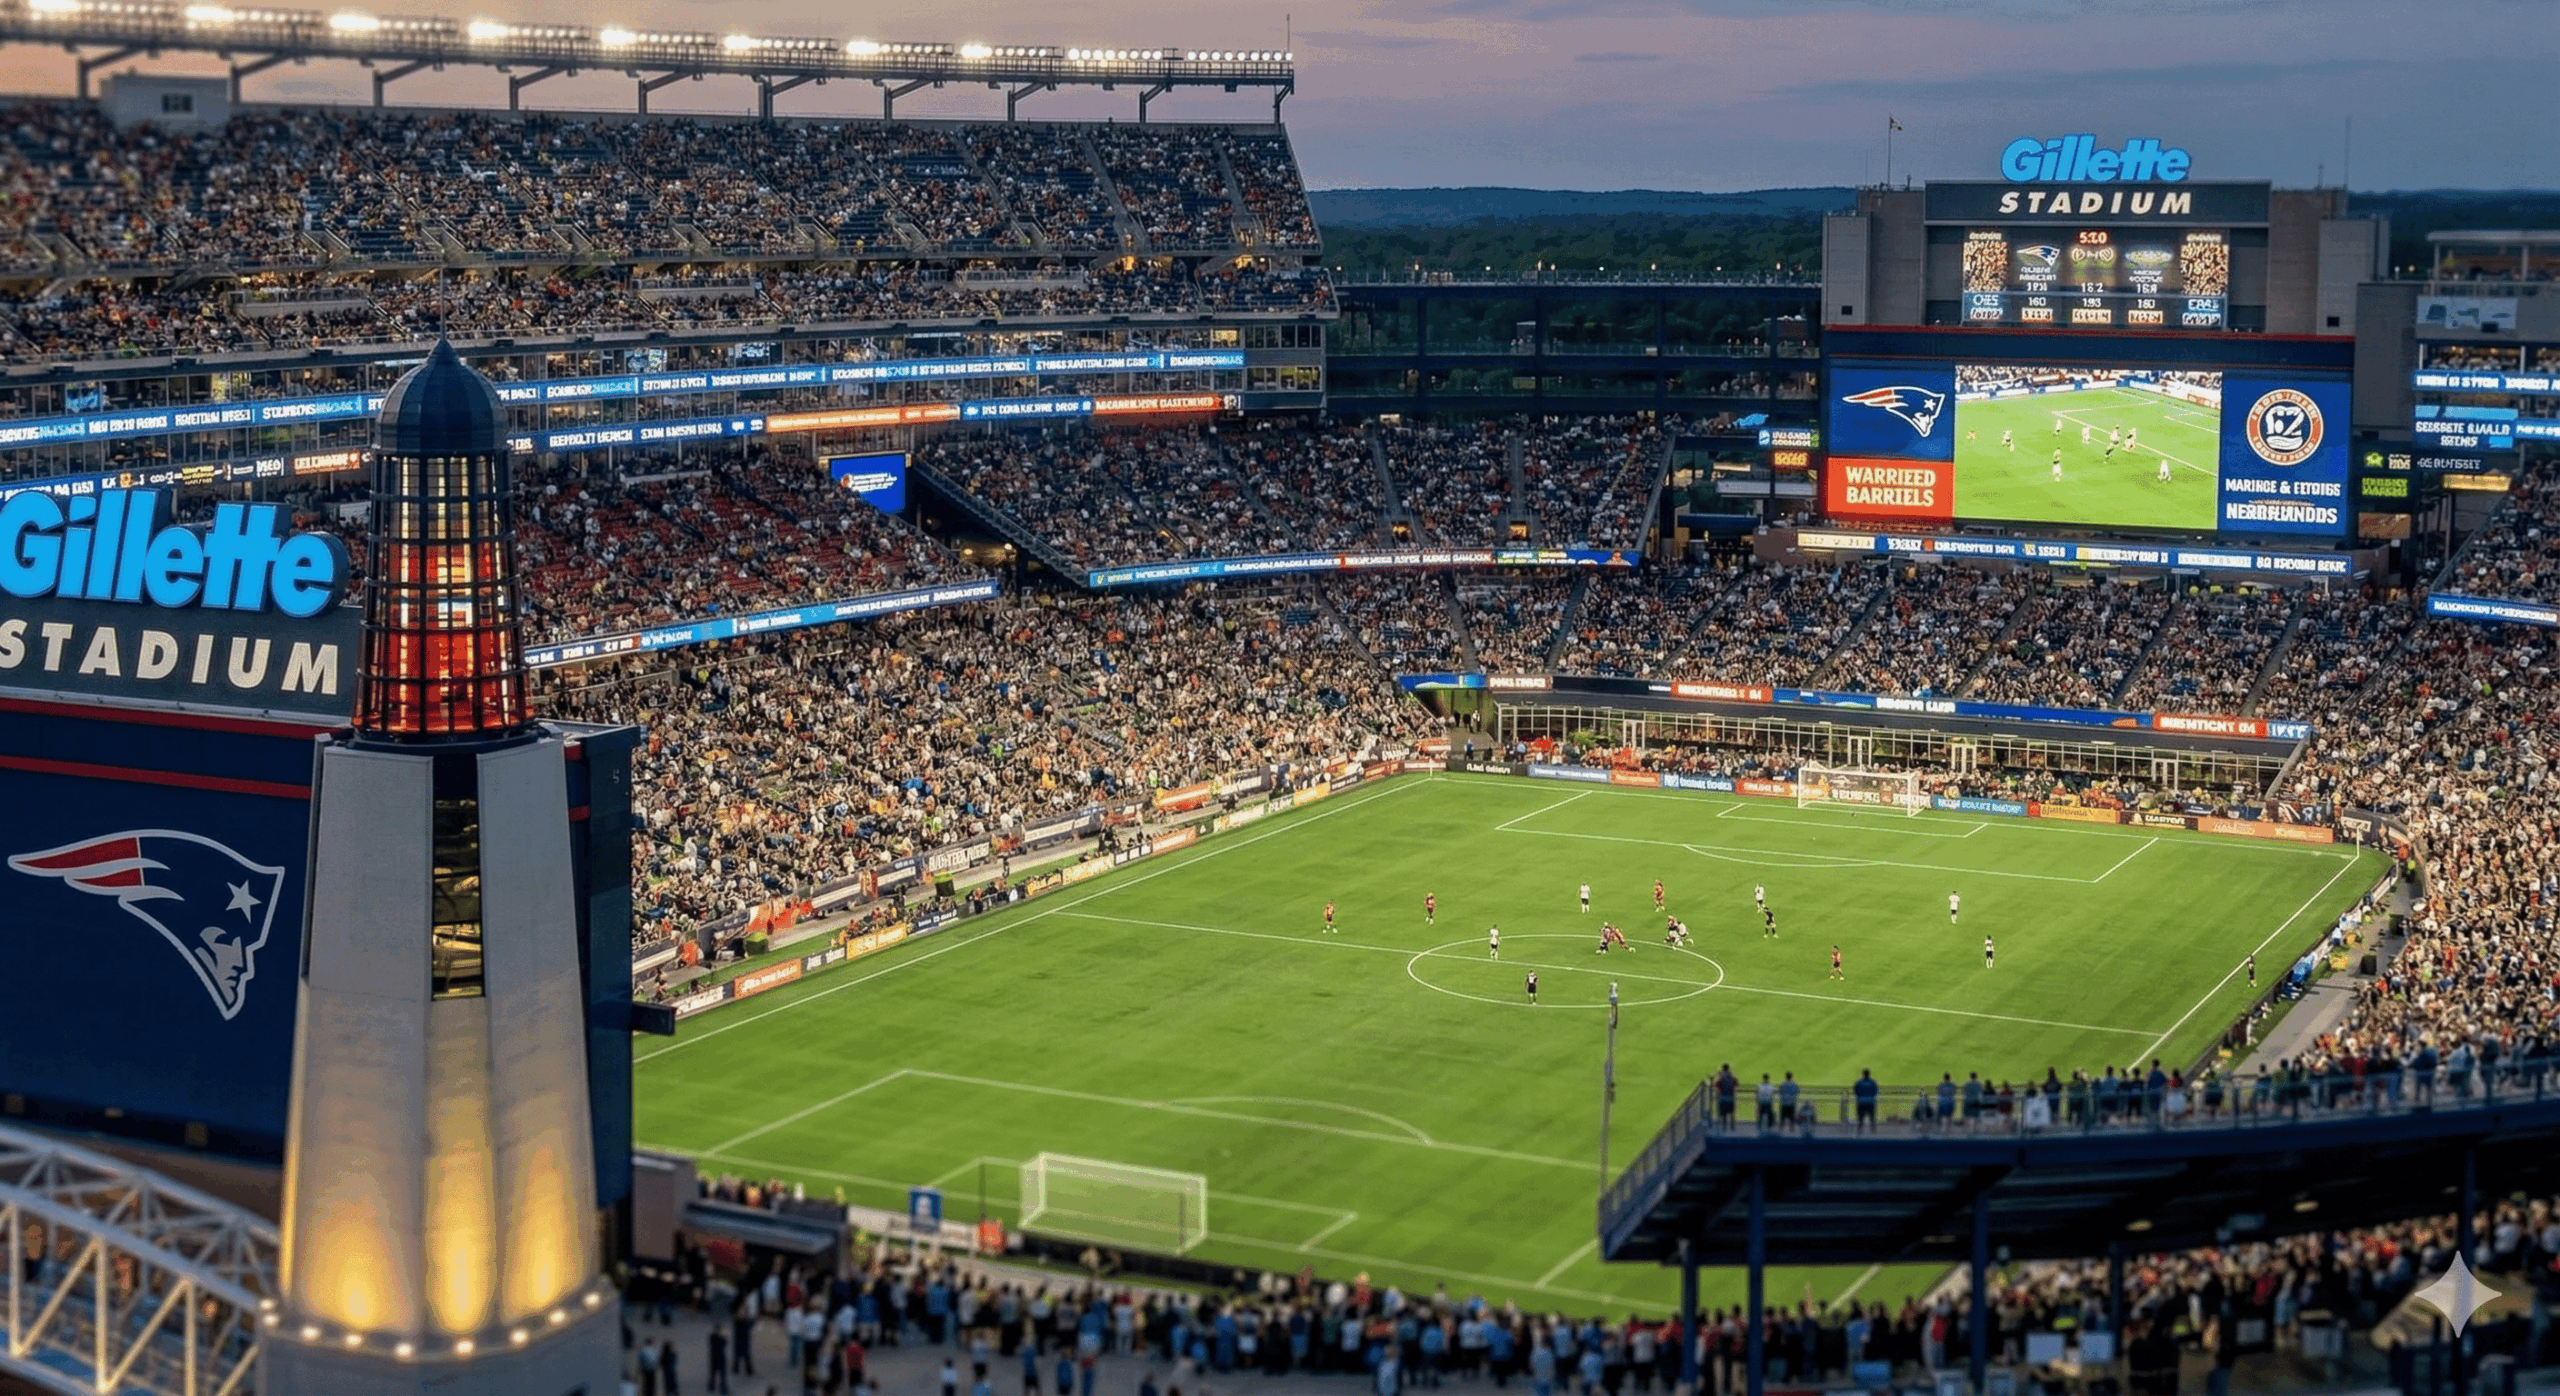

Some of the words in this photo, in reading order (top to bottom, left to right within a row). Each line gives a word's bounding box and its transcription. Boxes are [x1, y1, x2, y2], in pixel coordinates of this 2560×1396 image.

[2001, 133, 2192, 182] Gillette
[1998, 191, 2192, 214] STADIUM
[0, 488, 340, 619] Gillette
[0, 619, 340, 695] STADIUM
